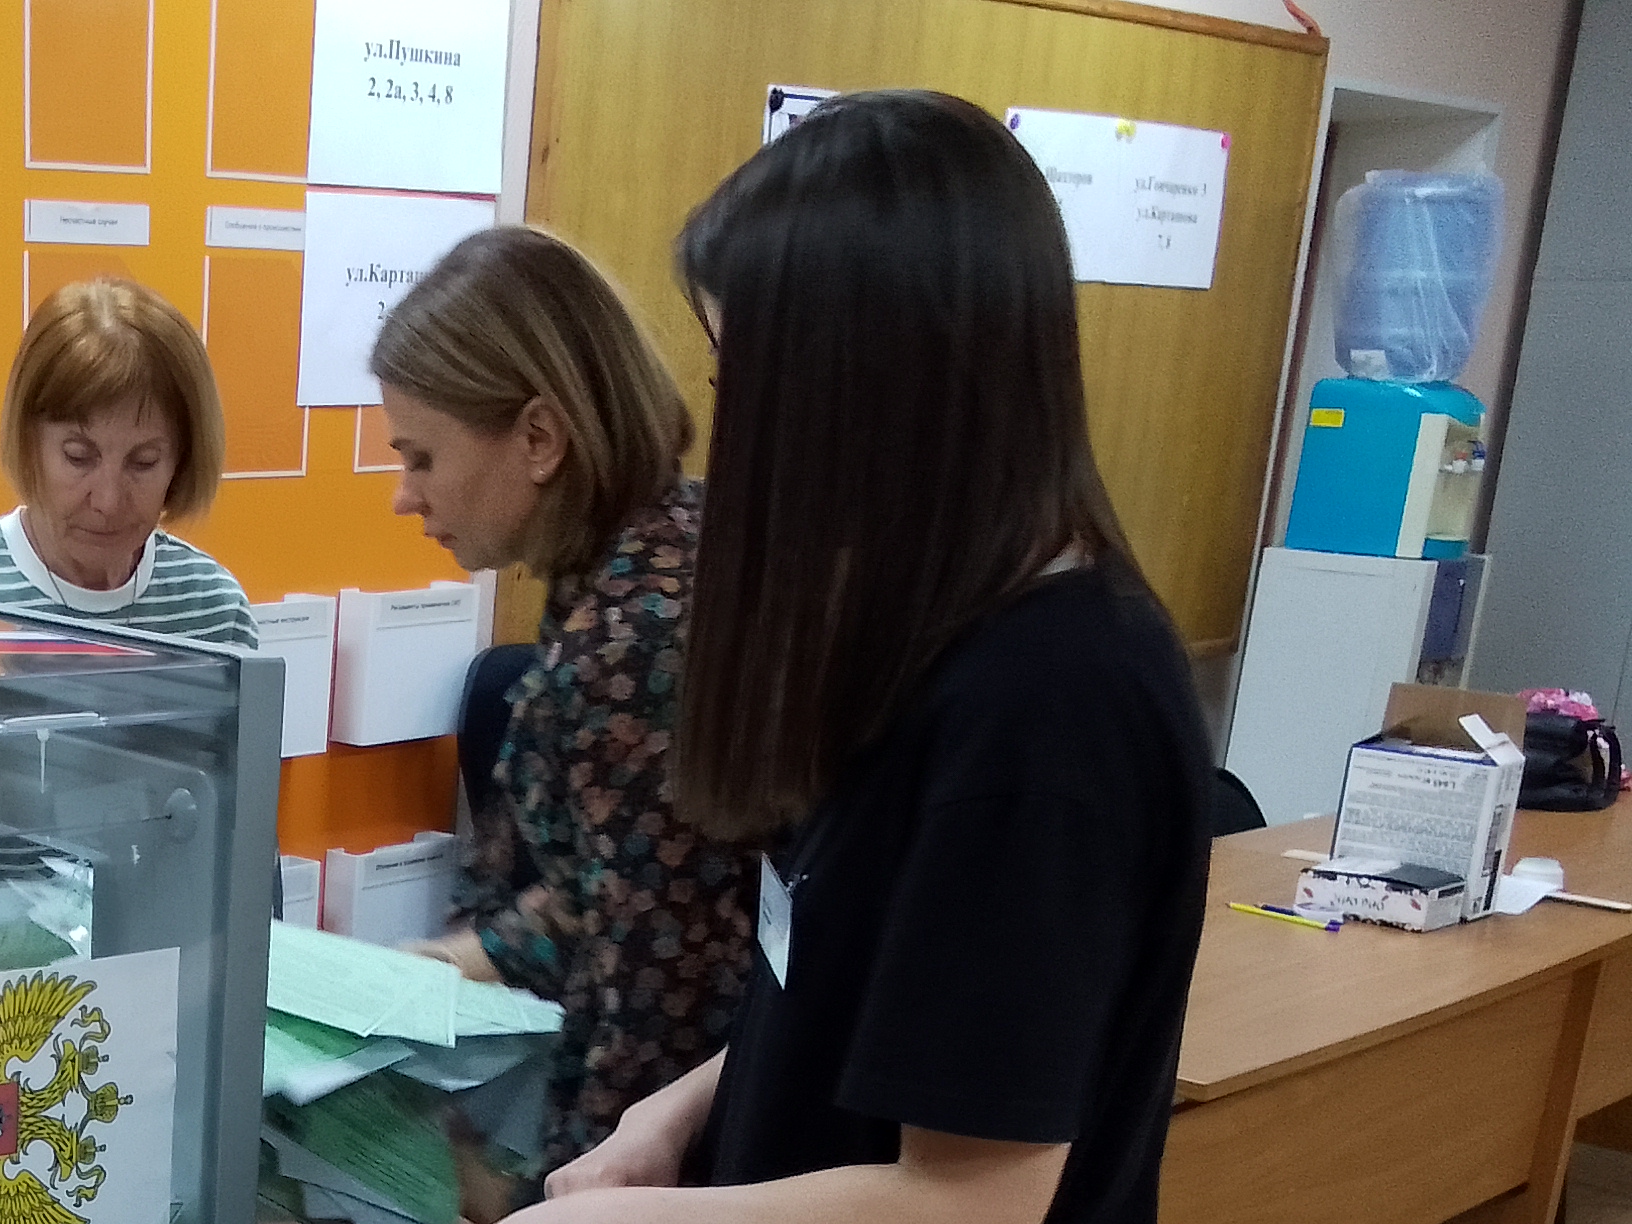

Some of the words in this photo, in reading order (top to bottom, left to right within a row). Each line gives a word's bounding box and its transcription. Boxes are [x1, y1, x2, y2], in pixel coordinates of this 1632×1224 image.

[363, 39, 460, 67] ул.Пушкина
[367, 77, 381, 101] 2,
[385, 79, 407, 103] 2а,
[410, 81, 423, 105] 3,
[428, 83, 441, 107] 4,
[445, 85, 453, 105] 8
